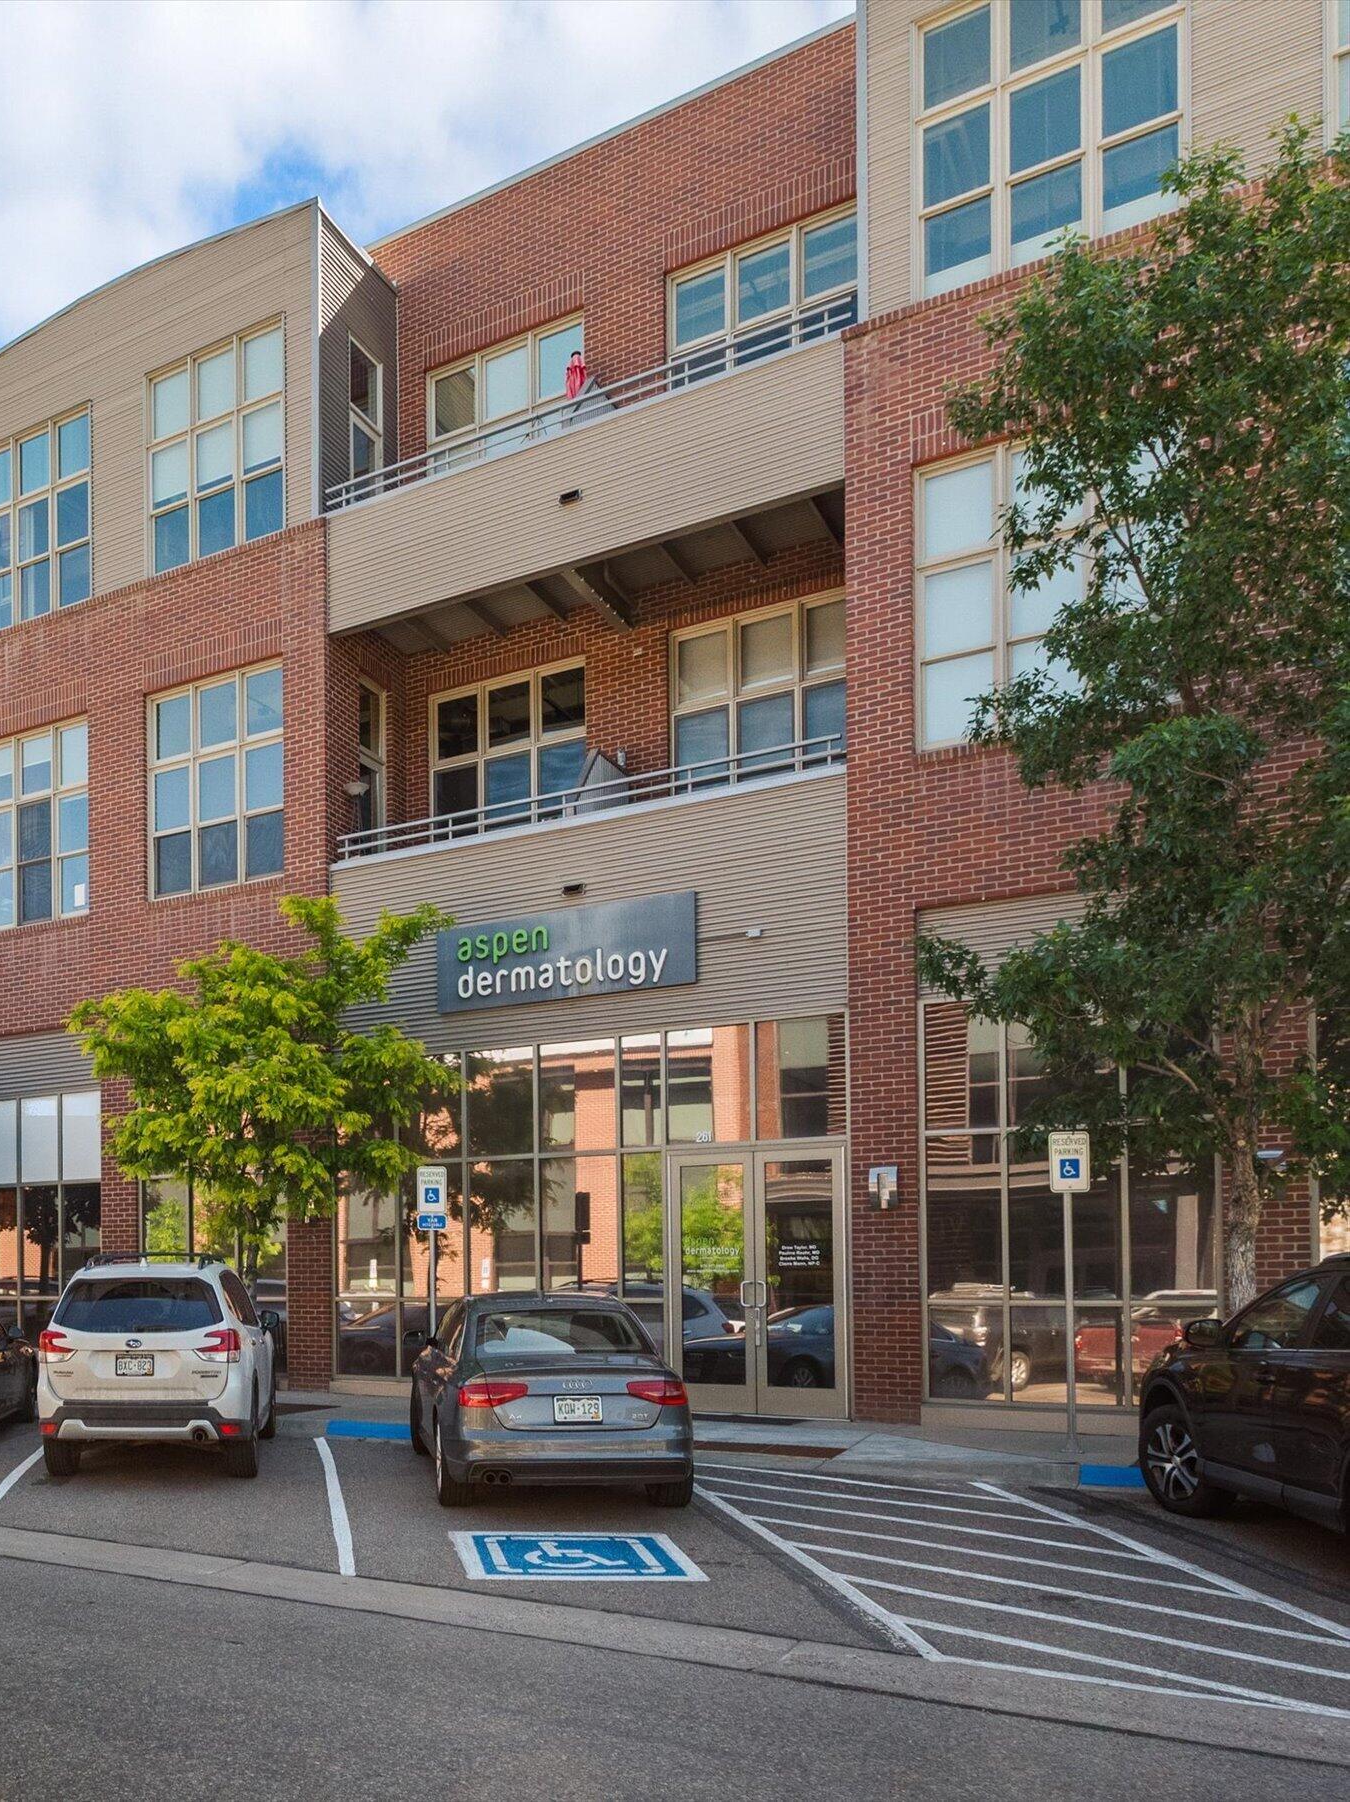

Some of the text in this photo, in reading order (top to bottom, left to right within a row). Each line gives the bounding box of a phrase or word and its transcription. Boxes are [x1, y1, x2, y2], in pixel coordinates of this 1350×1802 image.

[457, 925, 549, 964] aspen
[457, 948, 668, 999] dermatology
[696, 1130, 712, 1142] 261
[685, 1247, 740, 1256] dermatology
